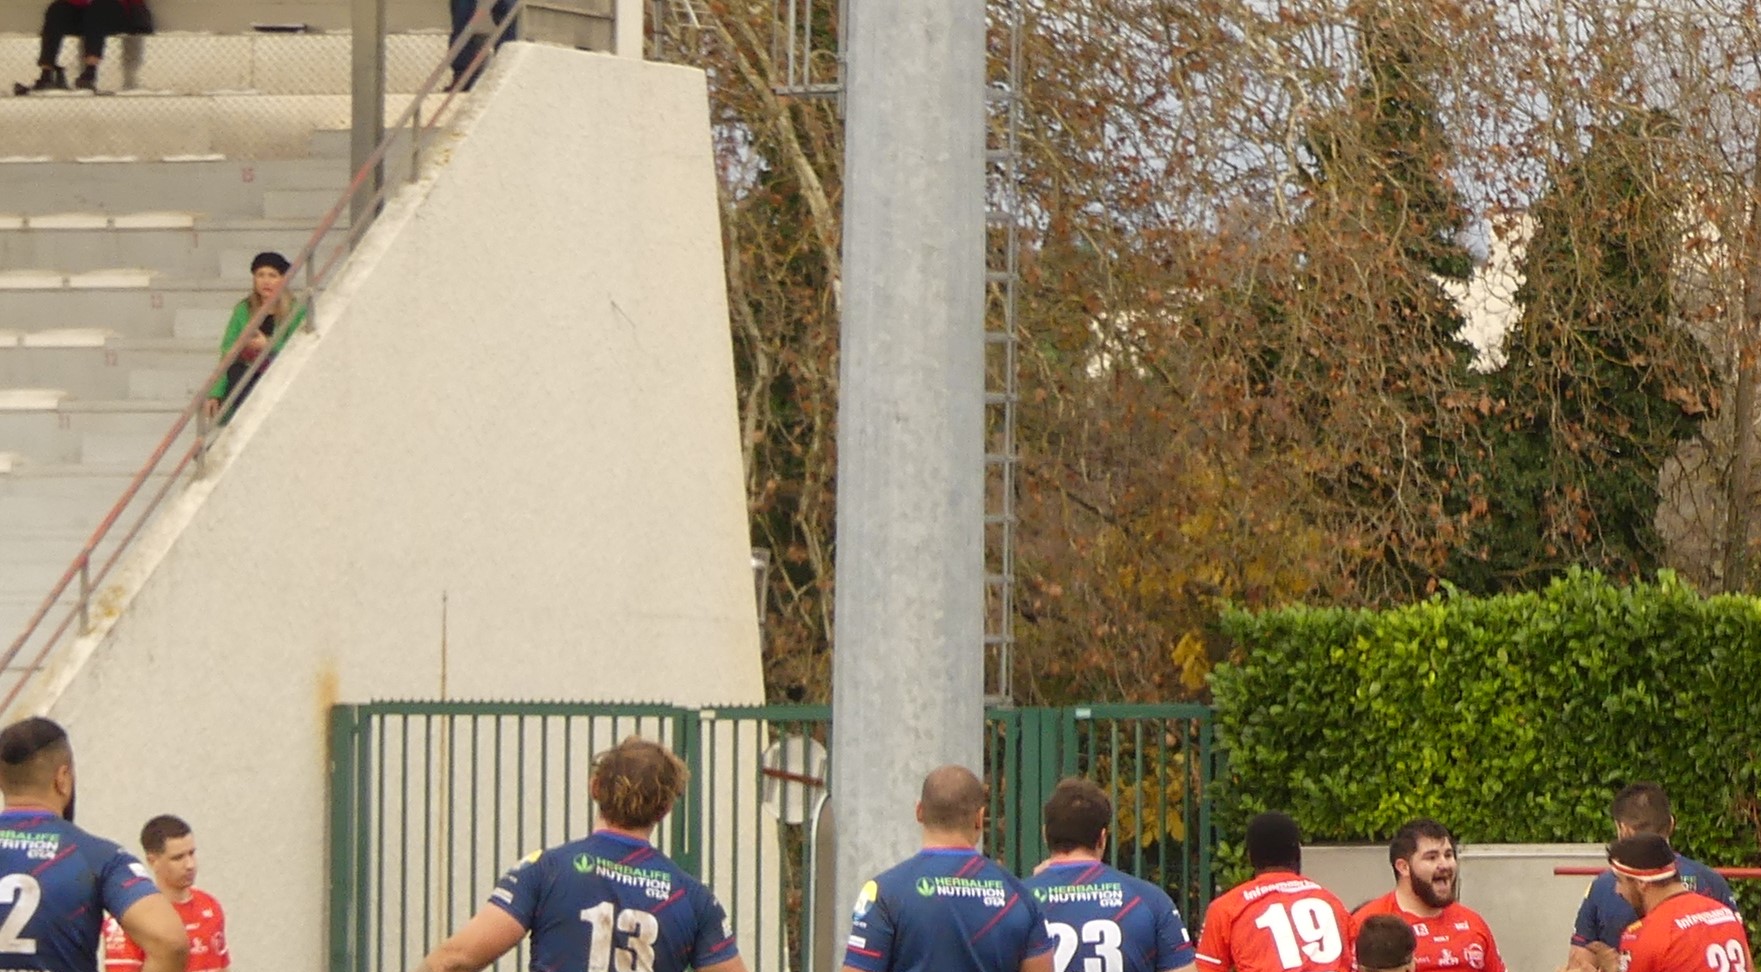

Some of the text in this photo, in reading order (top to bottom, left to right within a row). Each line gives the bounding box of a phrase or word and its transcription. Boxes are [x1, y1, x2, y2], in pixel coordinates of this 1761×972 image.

[596, 856, 672, 882] HERBALIFE
[596, 866, 671, 892] NUTRITION
[935, 876, 1004, 889] HERBALIFE
[937, 885, 1006, 898] NUTRITION
[1048, 882, 1121, 894] HERBALIFE
[1048, 890, 1123, 904] NUTRITION
[1255, 897, 1343, 970] 19
